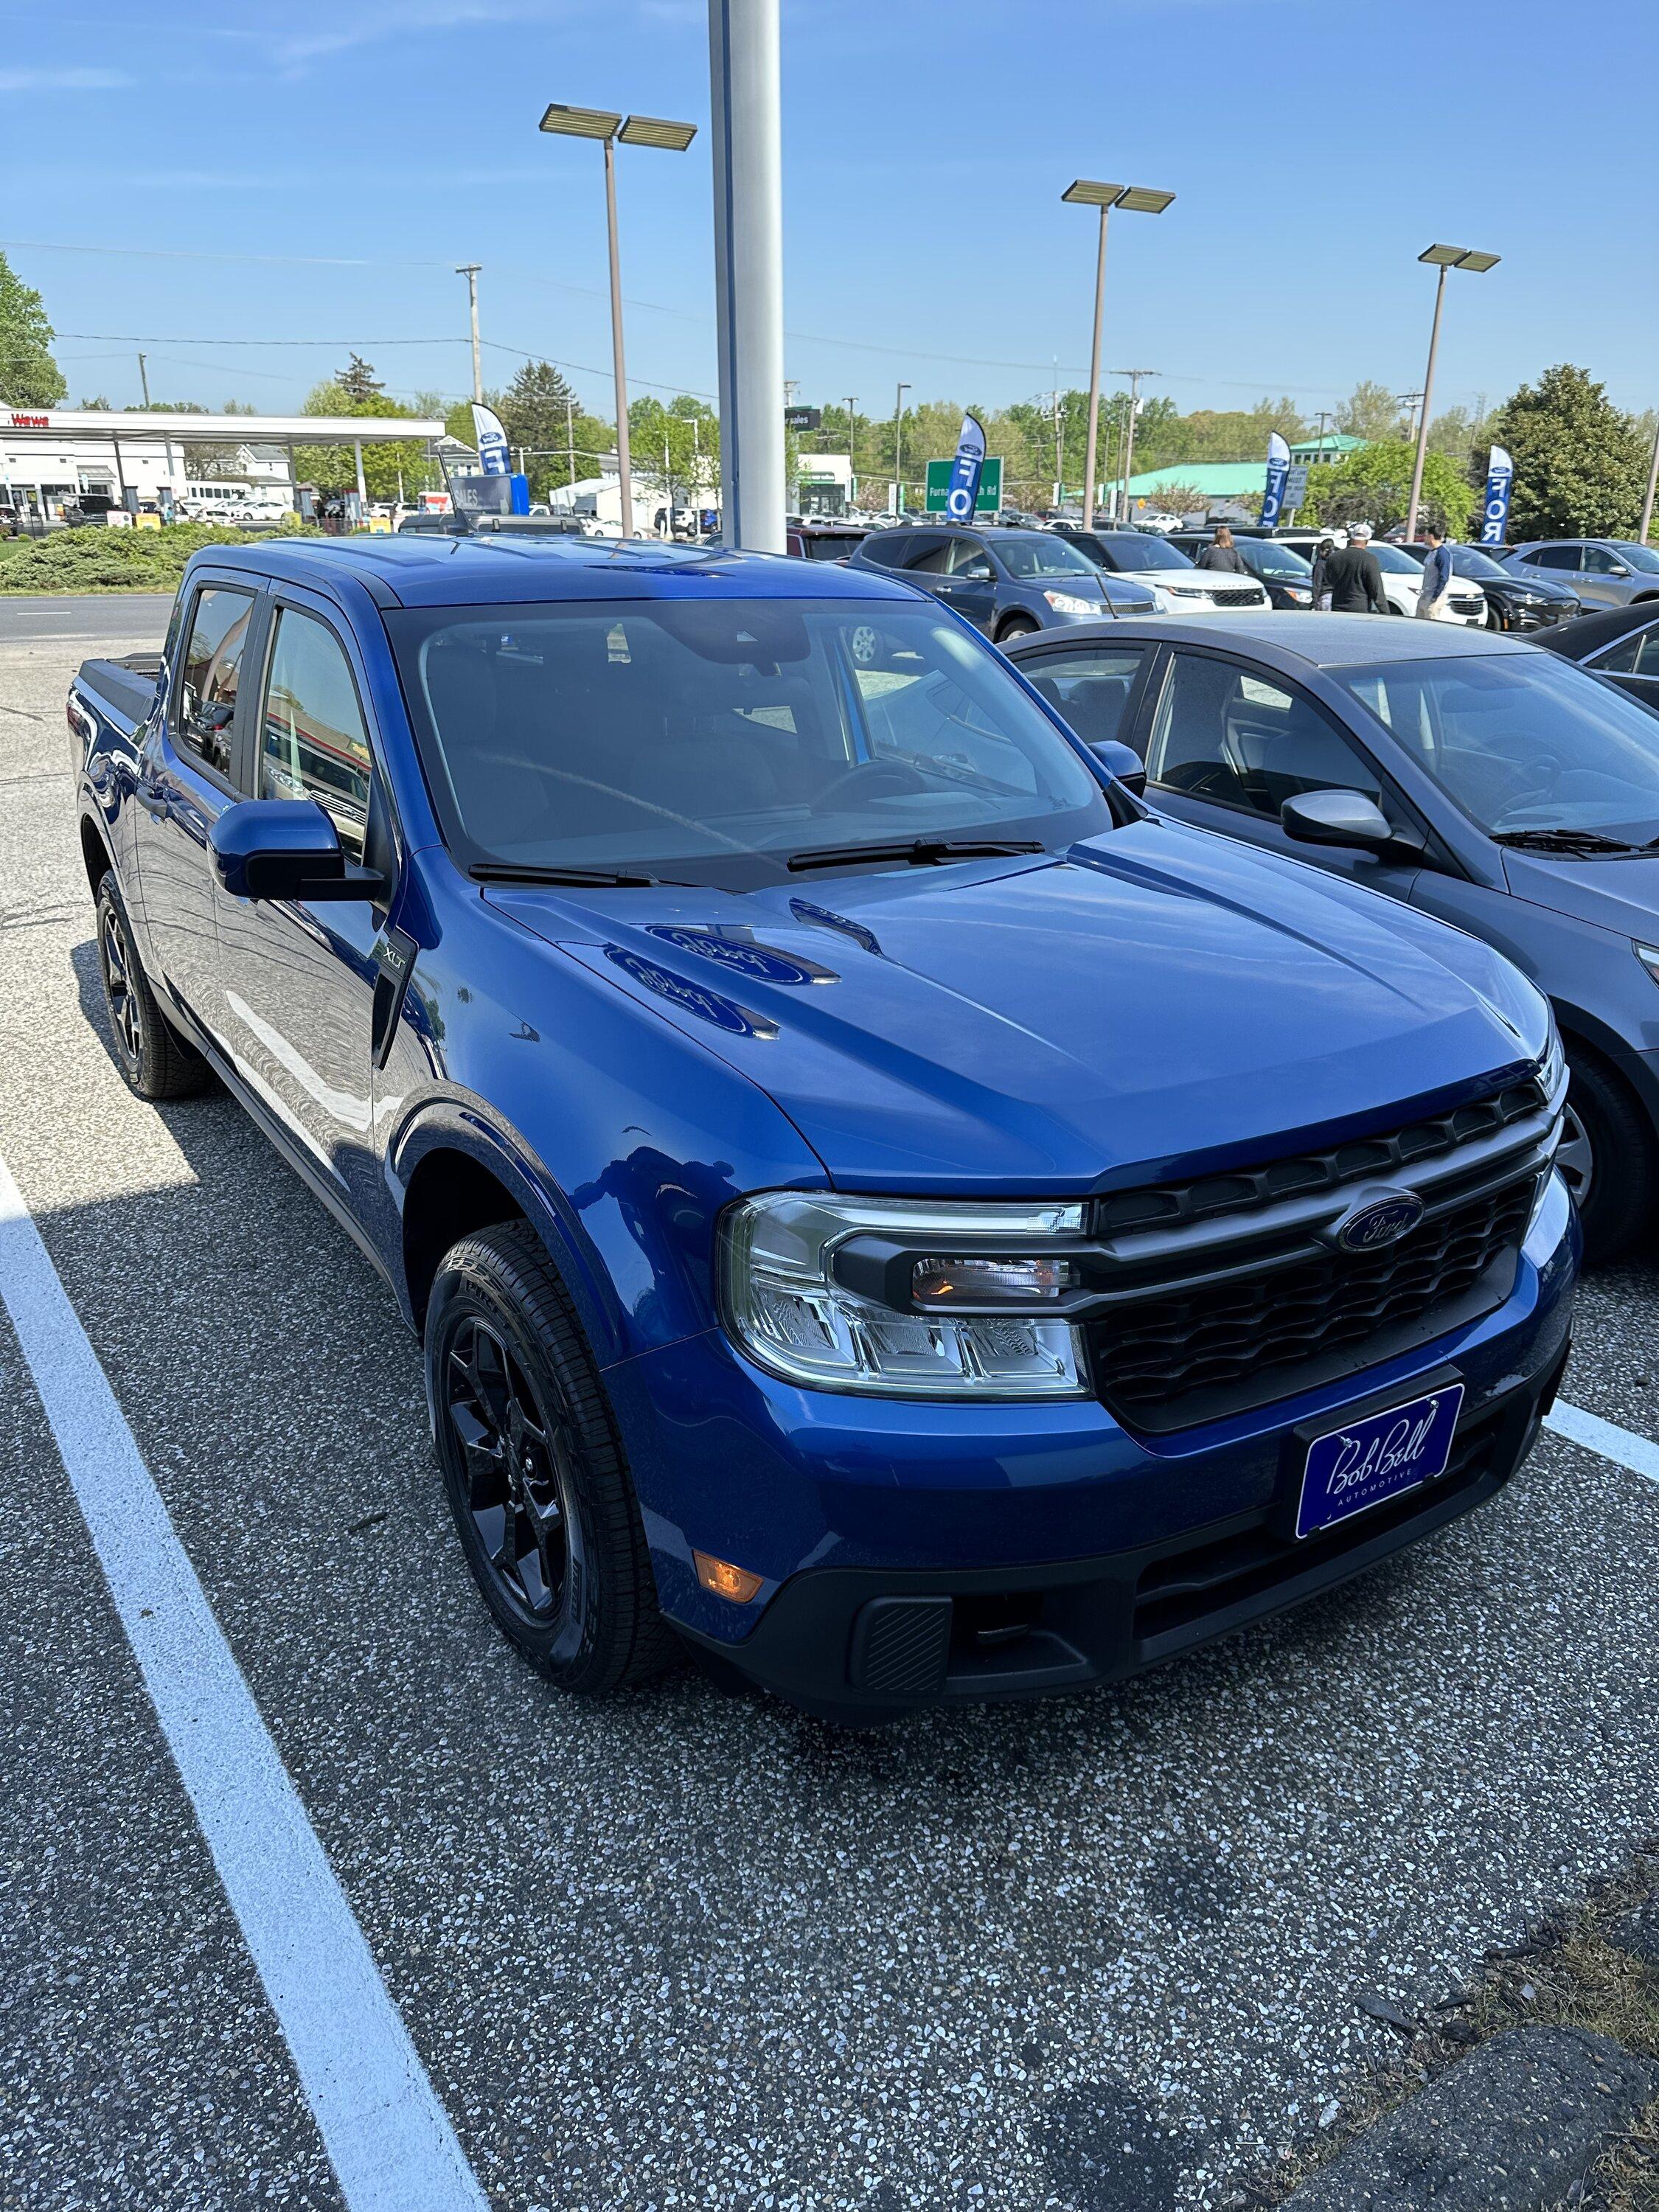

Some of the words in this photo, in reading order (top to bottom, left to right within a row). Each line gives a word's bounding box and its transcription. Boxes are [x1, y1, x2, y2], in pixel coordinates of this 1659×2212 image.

[383, 946, 406, 969] XLT
[1363, 1210, 1409, 1243] Ford
[1326, 1438, 1380, 1494] Bob
[1374, 1408, 1436, 1475] Bell
[1338, 1468, 1412, 1506] AUTOMOTIVE
